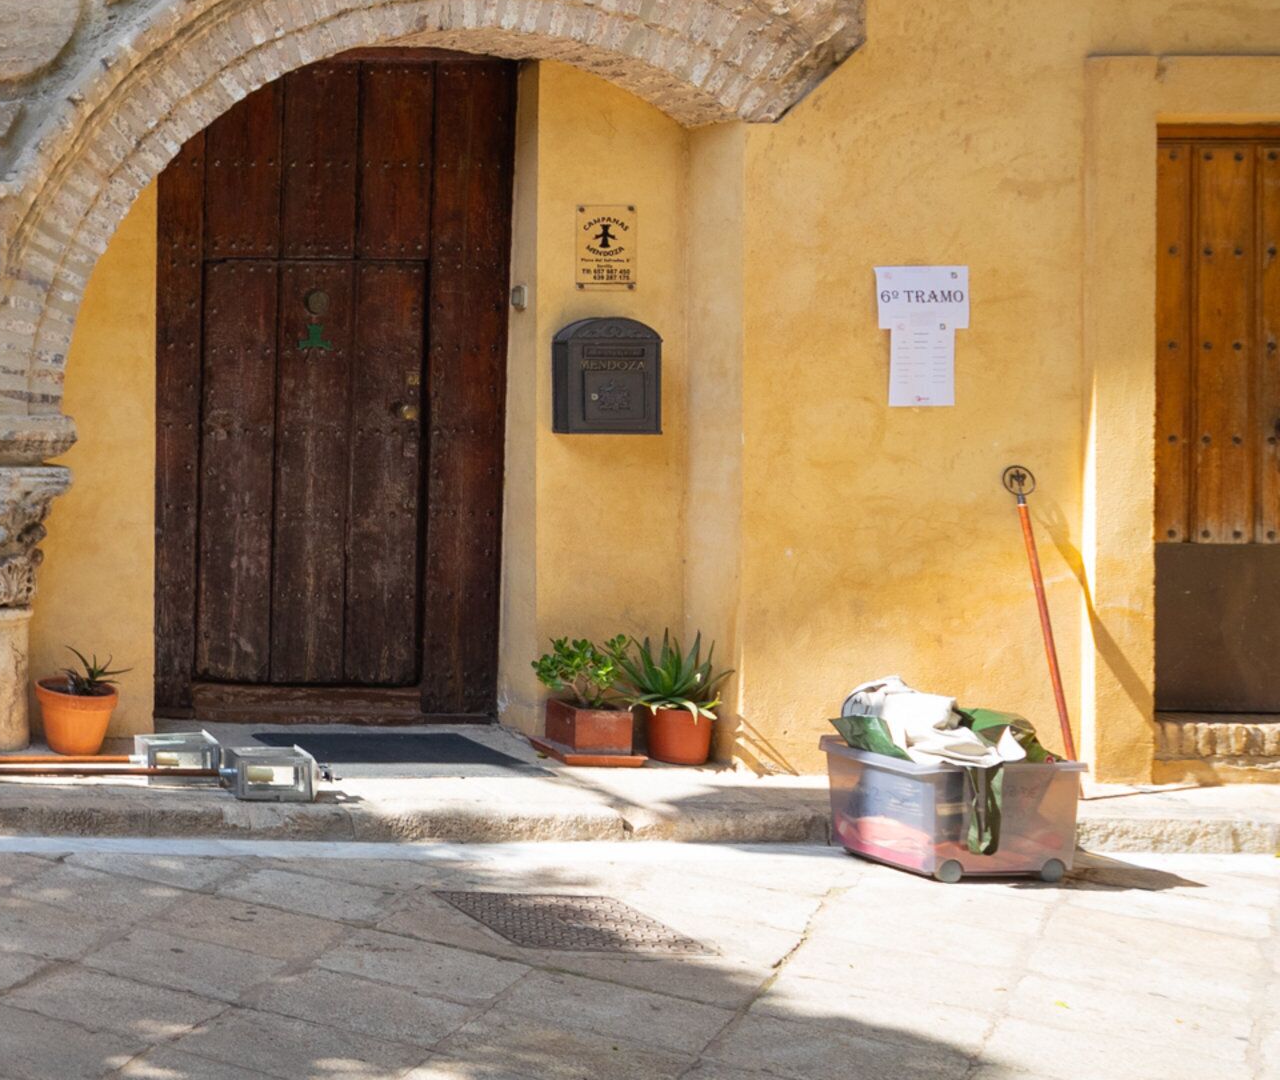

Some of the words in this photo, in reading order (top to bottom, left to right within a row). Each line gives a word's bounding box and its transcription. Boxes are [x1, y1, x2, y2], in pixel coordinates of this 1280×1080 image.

[583, 217, 629, 231] CAMPANAS
[585, 245, 625, 257] MENDOZA
[880, 290, 899, 303] 6º
[903, 290, 965, 303] TRAMO
[581, 360, 646, 371] MENDOZA
